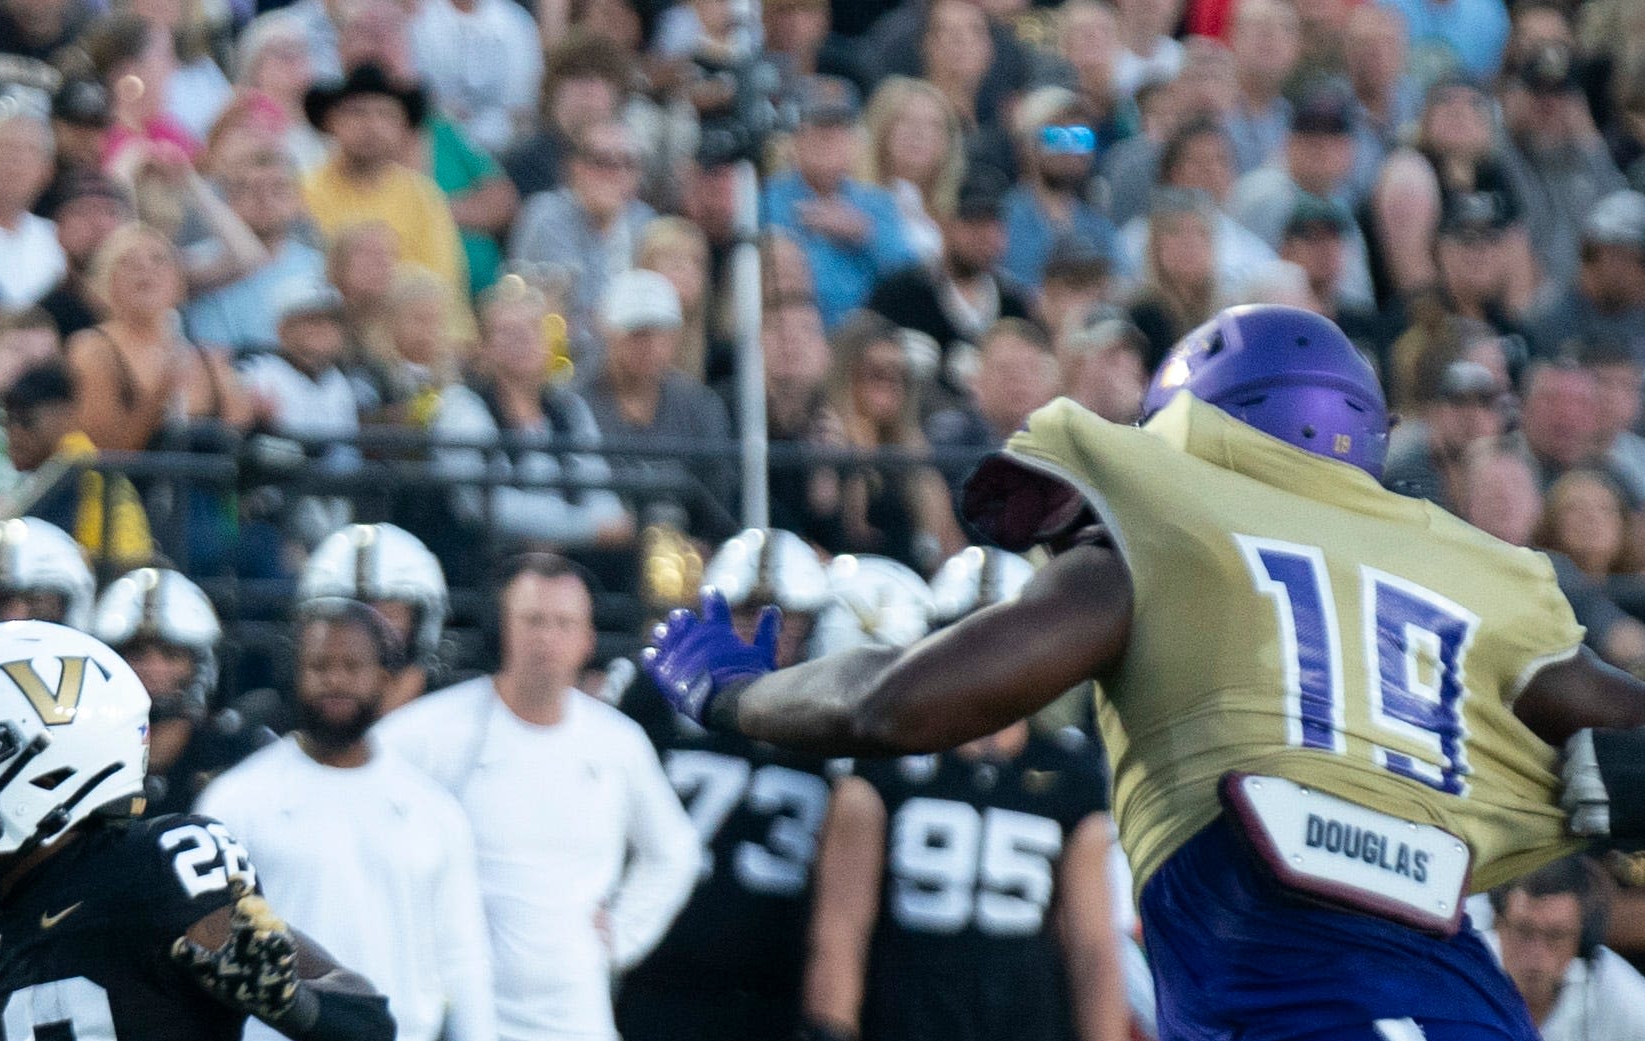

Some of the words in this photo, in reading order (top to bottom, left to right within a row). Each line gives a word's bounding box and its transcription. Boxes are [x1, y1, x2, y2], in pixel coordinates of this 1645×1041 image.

[1334, 433, 1352, 453] 19
[1232, 532, 1482, 799] 19
[662, 748, 831, 894] 73
[890, 796, 1063, 937] 95
[1305, 813, 1429, 884] DOUGLAS
